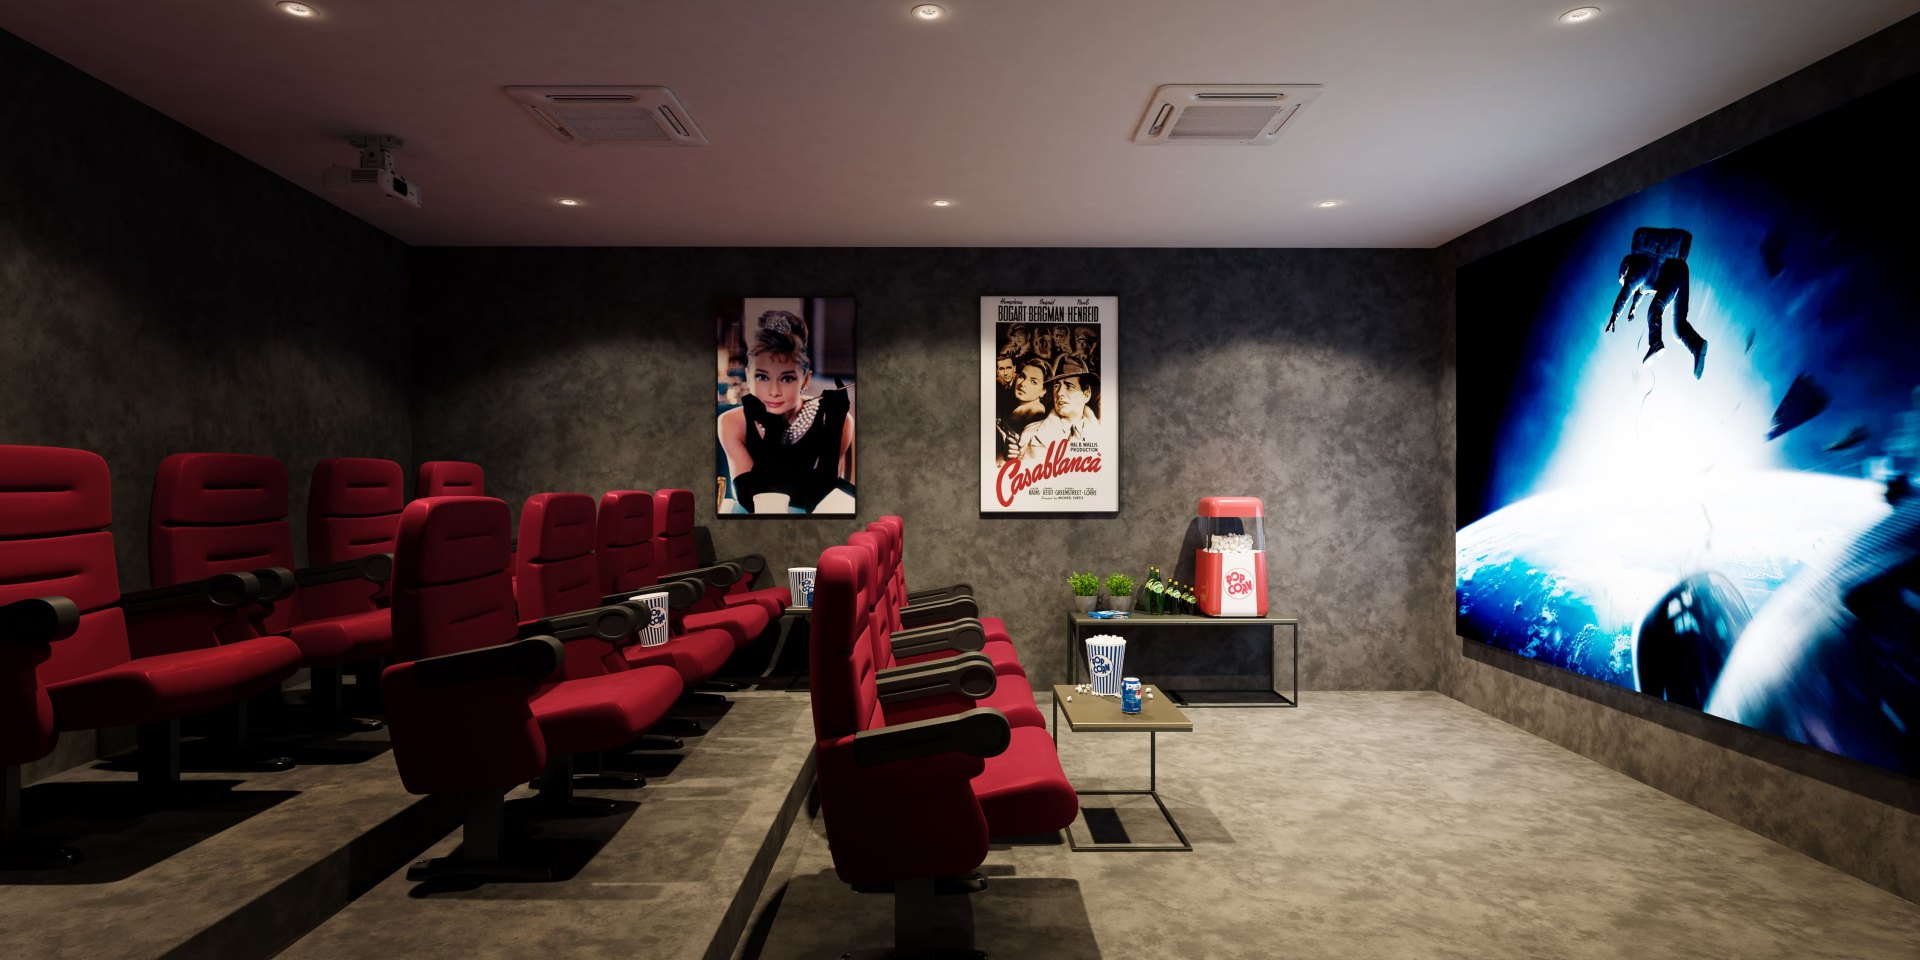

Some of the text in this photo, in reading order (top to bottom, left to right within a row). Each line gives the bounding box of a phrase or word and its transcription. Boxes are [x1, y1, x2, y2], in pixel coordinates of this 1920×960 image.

[998, 305, 1099, 322] BOGART BERGMAN HENREID
[1226, 571, 1245, 585] POP
[1228, 580, 1252, 594] CORN
